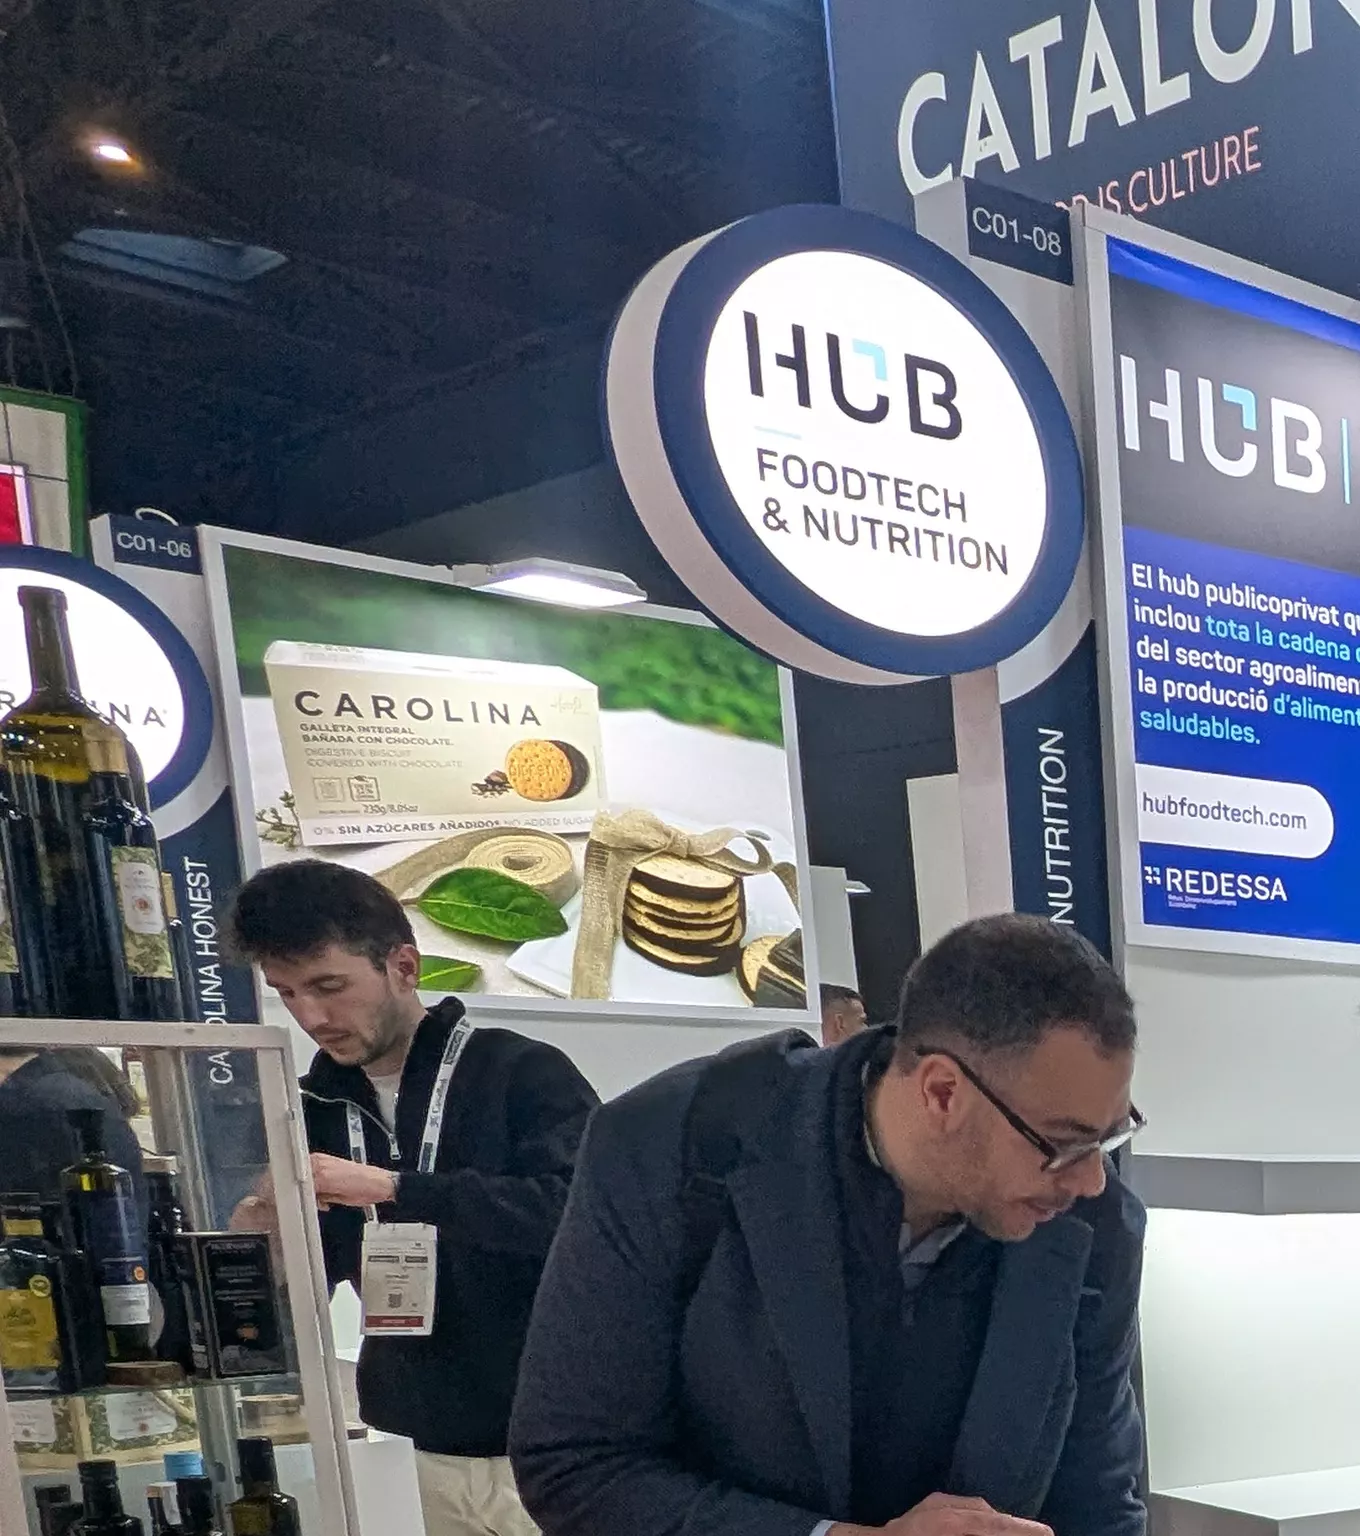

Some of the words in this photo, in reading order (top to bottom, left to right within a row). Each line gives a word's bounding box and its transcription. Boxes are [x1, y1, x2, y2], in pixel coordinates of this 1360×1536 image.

[1128, 125, 1262, 213] CULTURE
[972, 206, 1062, 257] C01-08
[743, 310, 962, 441] HUB
[1119, 354, 1328, 495] HUB
[756, 447, 967, 524] FOODTECH
[116, 532, 192, 558] C01-06
[762, 497, 790, 534] &
[803, 504, 1009, 575] NUTRITION
[1131, 562, 1153, 589] El
[1158, 567, 1200, 598] hub
[1205, 582, 1340, 627] publicoprivat
[1134, 598, 1200, 633] inclou
[1205, 614, 1250, 642] tota
[1255, 621, 1273, 646] la
[1279, 630, 1351, 661] cadena
[1136, 635, 1170, 662] del
[1175, 643, 1245, 675] sector
[294, 690, 542, 727] CAROLINA
[1137, 668, 1157, 695] la
[1163, 679, 1268, 712] producció
[299, 722, 355, 735] GALLETA
[357, 724, 415, 736] INTEGRAL
[302, 733, 354, 744] BAÑADA
[357, 735, 383, 745] CON
[1139, 707, 1262, 745] saludables.
[338, 823, 361, 835] SIN
[365, 820, 435, 834] AZÚCARES
[1037, 727, 1075, 925] NUTRITION
[1141, 791, 1308, 830] hubfoodtech.com
[184, 856, 221, 958] HONEST
[1165, 867, 1288, 902] REDESSA
